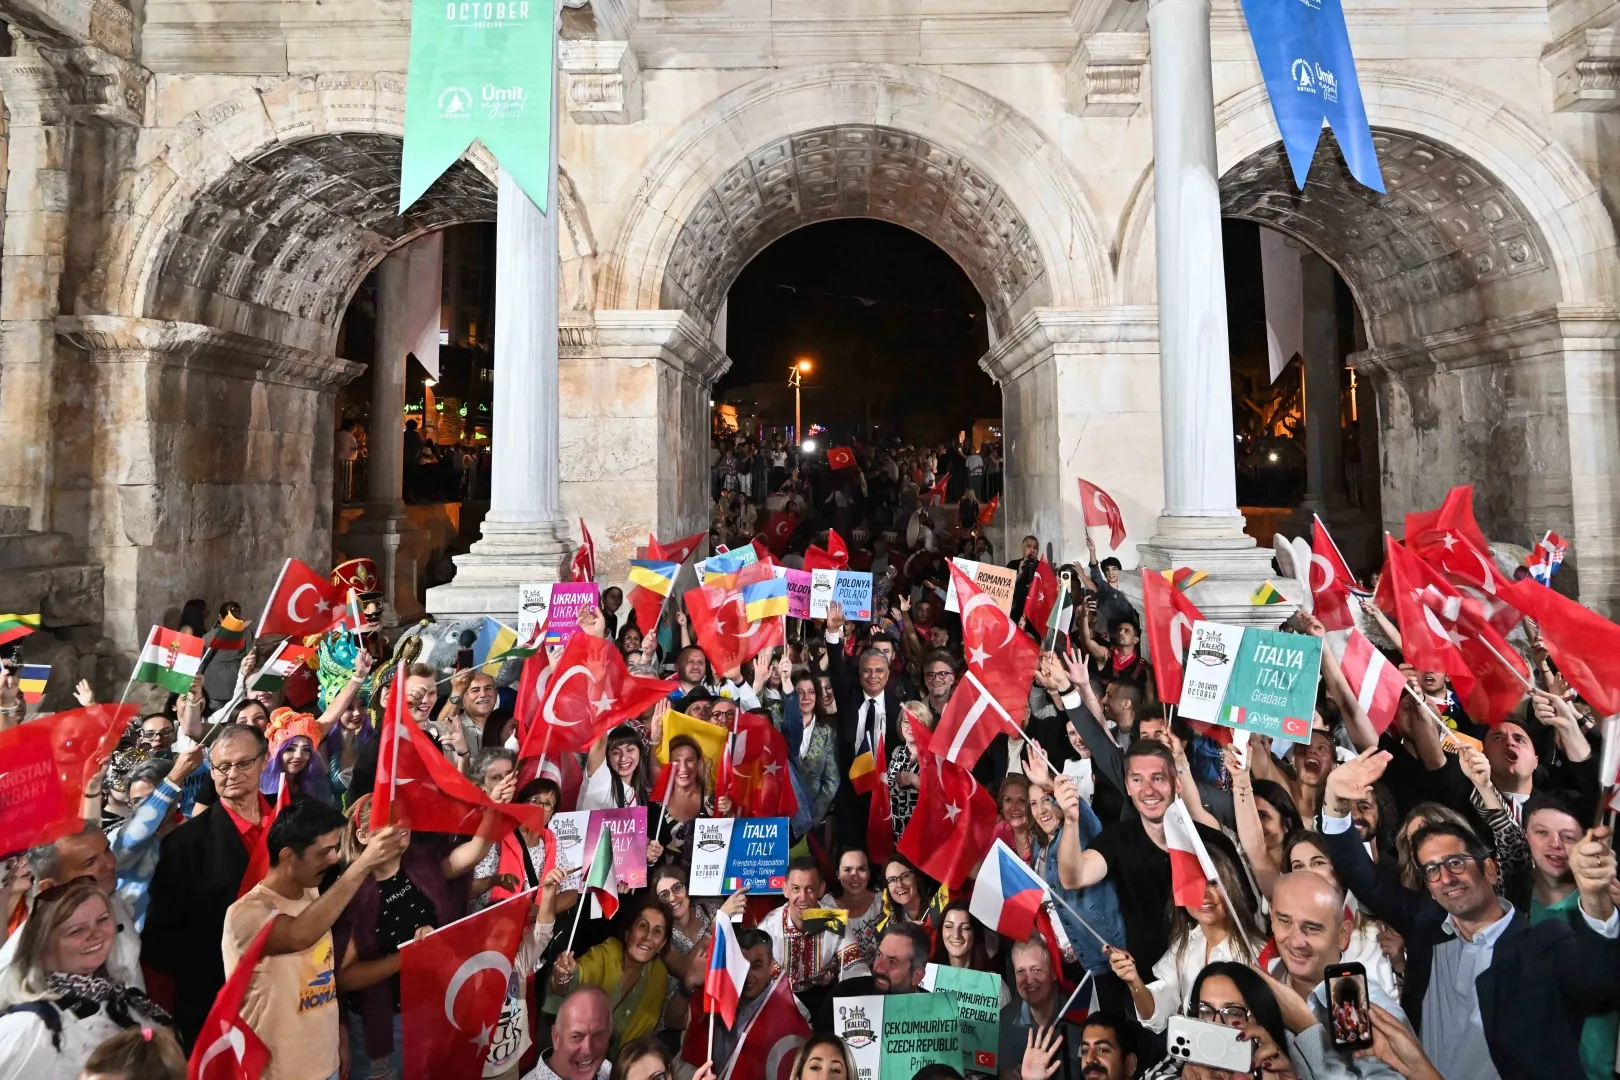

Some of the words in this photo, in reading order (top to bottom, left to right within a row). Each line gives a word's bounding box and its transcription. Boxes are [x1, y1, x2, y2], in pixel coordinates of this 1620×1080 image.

[446, 1, 529, 20] OCTOBER
[482, 83, 524, 101] Ümit
[837, 577, 870, 589] POLONYA
[977, 571, 1012, 588] ROMANYA
[552, 592, 594, 605] UKRAYNA
[838, 588, 868, 599] POLAND
[1253, 640, 1304, 670] İTALYA
[1256, 668, 1298, 691] ITALY
[1187, 687, 1217, 699] OCTOBER
[1251, 688, 1288, 707] Gradara
[742, 821, 778, 839] İTALYA
[746, 841, 775, 856] ITALY
[732, 859, 758, 868] Friendship
[757, 858, 785, 866] Association
[955, 991, 999, 1009] UMHURİYETİ
[960, 1006, 998, 1024] REPUBLIC
[884, 1022, 900, 1038] ÇEK
[901, 1016, 958, 1035] CUMHURİYETİ
[887, 1040, 915, 1054] CZECH
[916, 1037, 959, 1052] REPUBLIC
